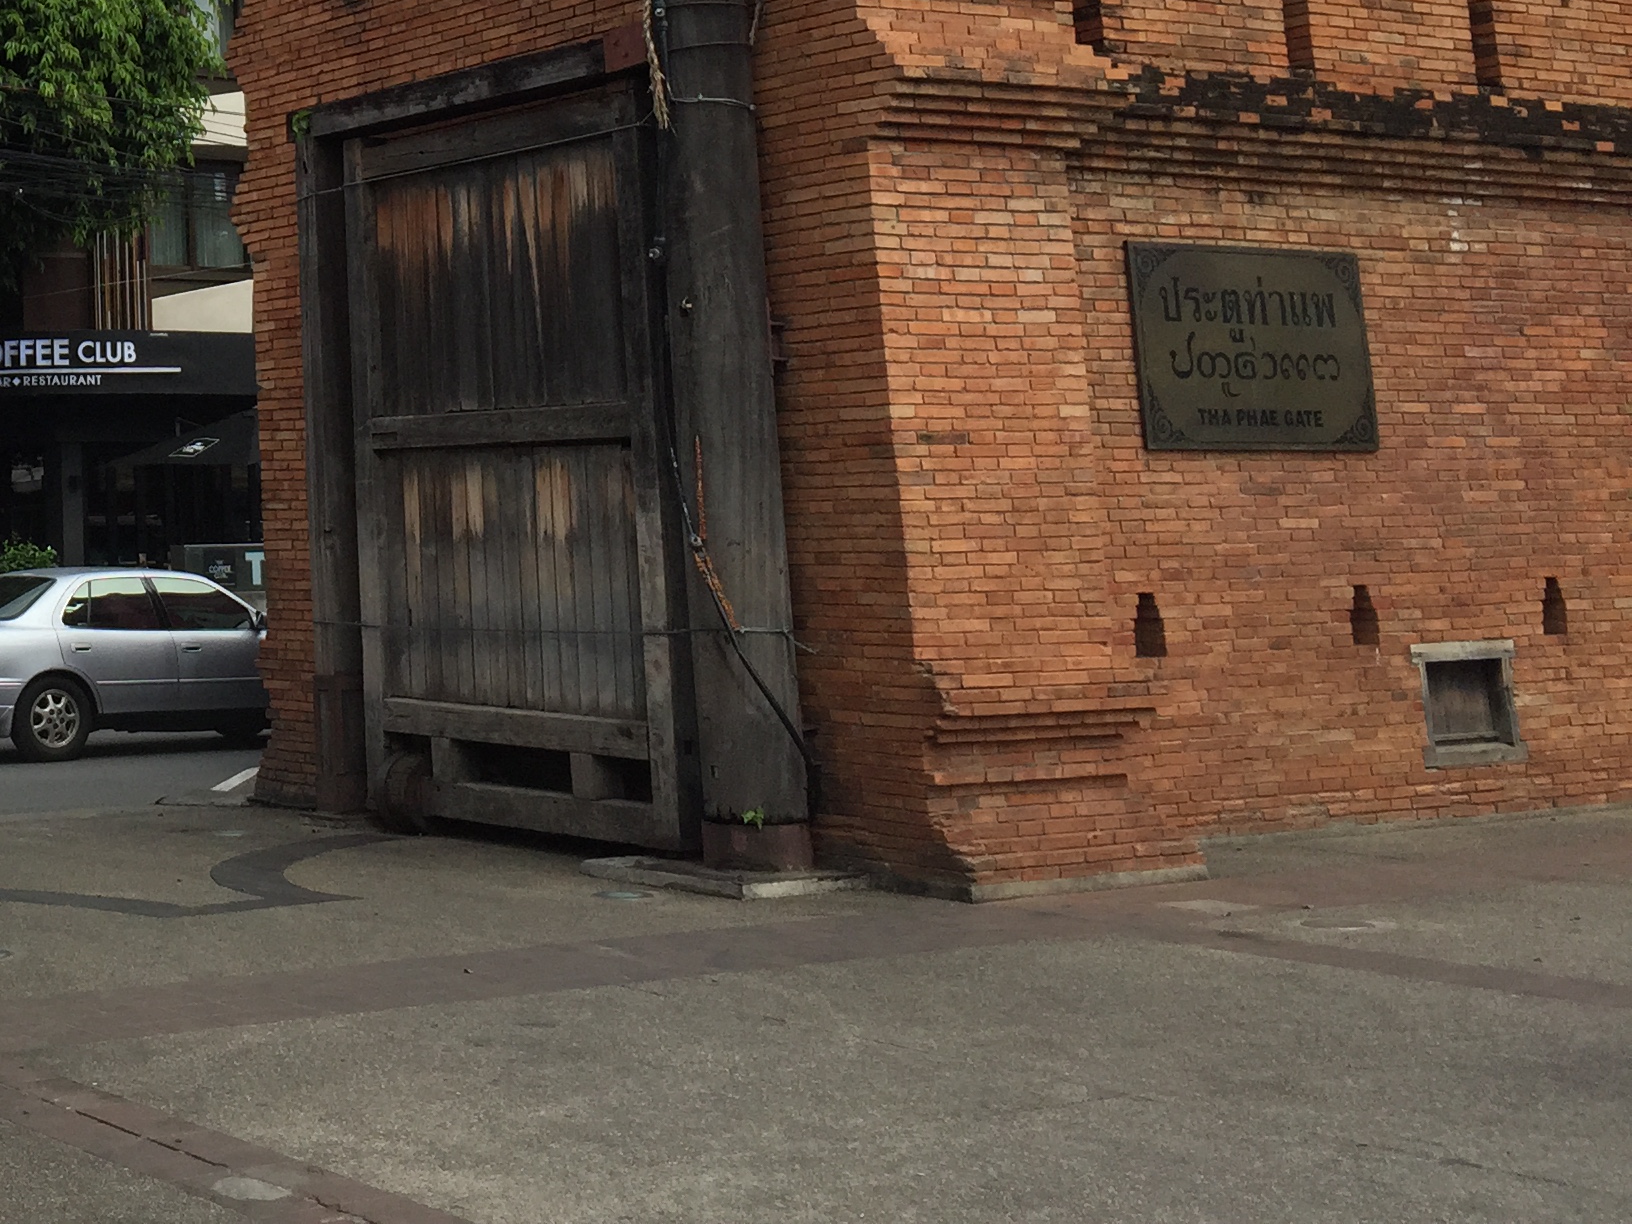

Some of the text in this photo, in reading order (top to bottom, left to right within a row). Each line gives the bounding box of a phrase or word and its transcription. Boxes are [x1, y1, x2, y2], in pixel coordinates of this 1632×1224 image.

[1159, 276, 1337, 343] ประตูท่าแพ
[77, 341, 137, 364] CLUB
[23, 375, 102, 387] RESTAURANT
[1197, 408, 1324, 428] THA PHAE GATE
